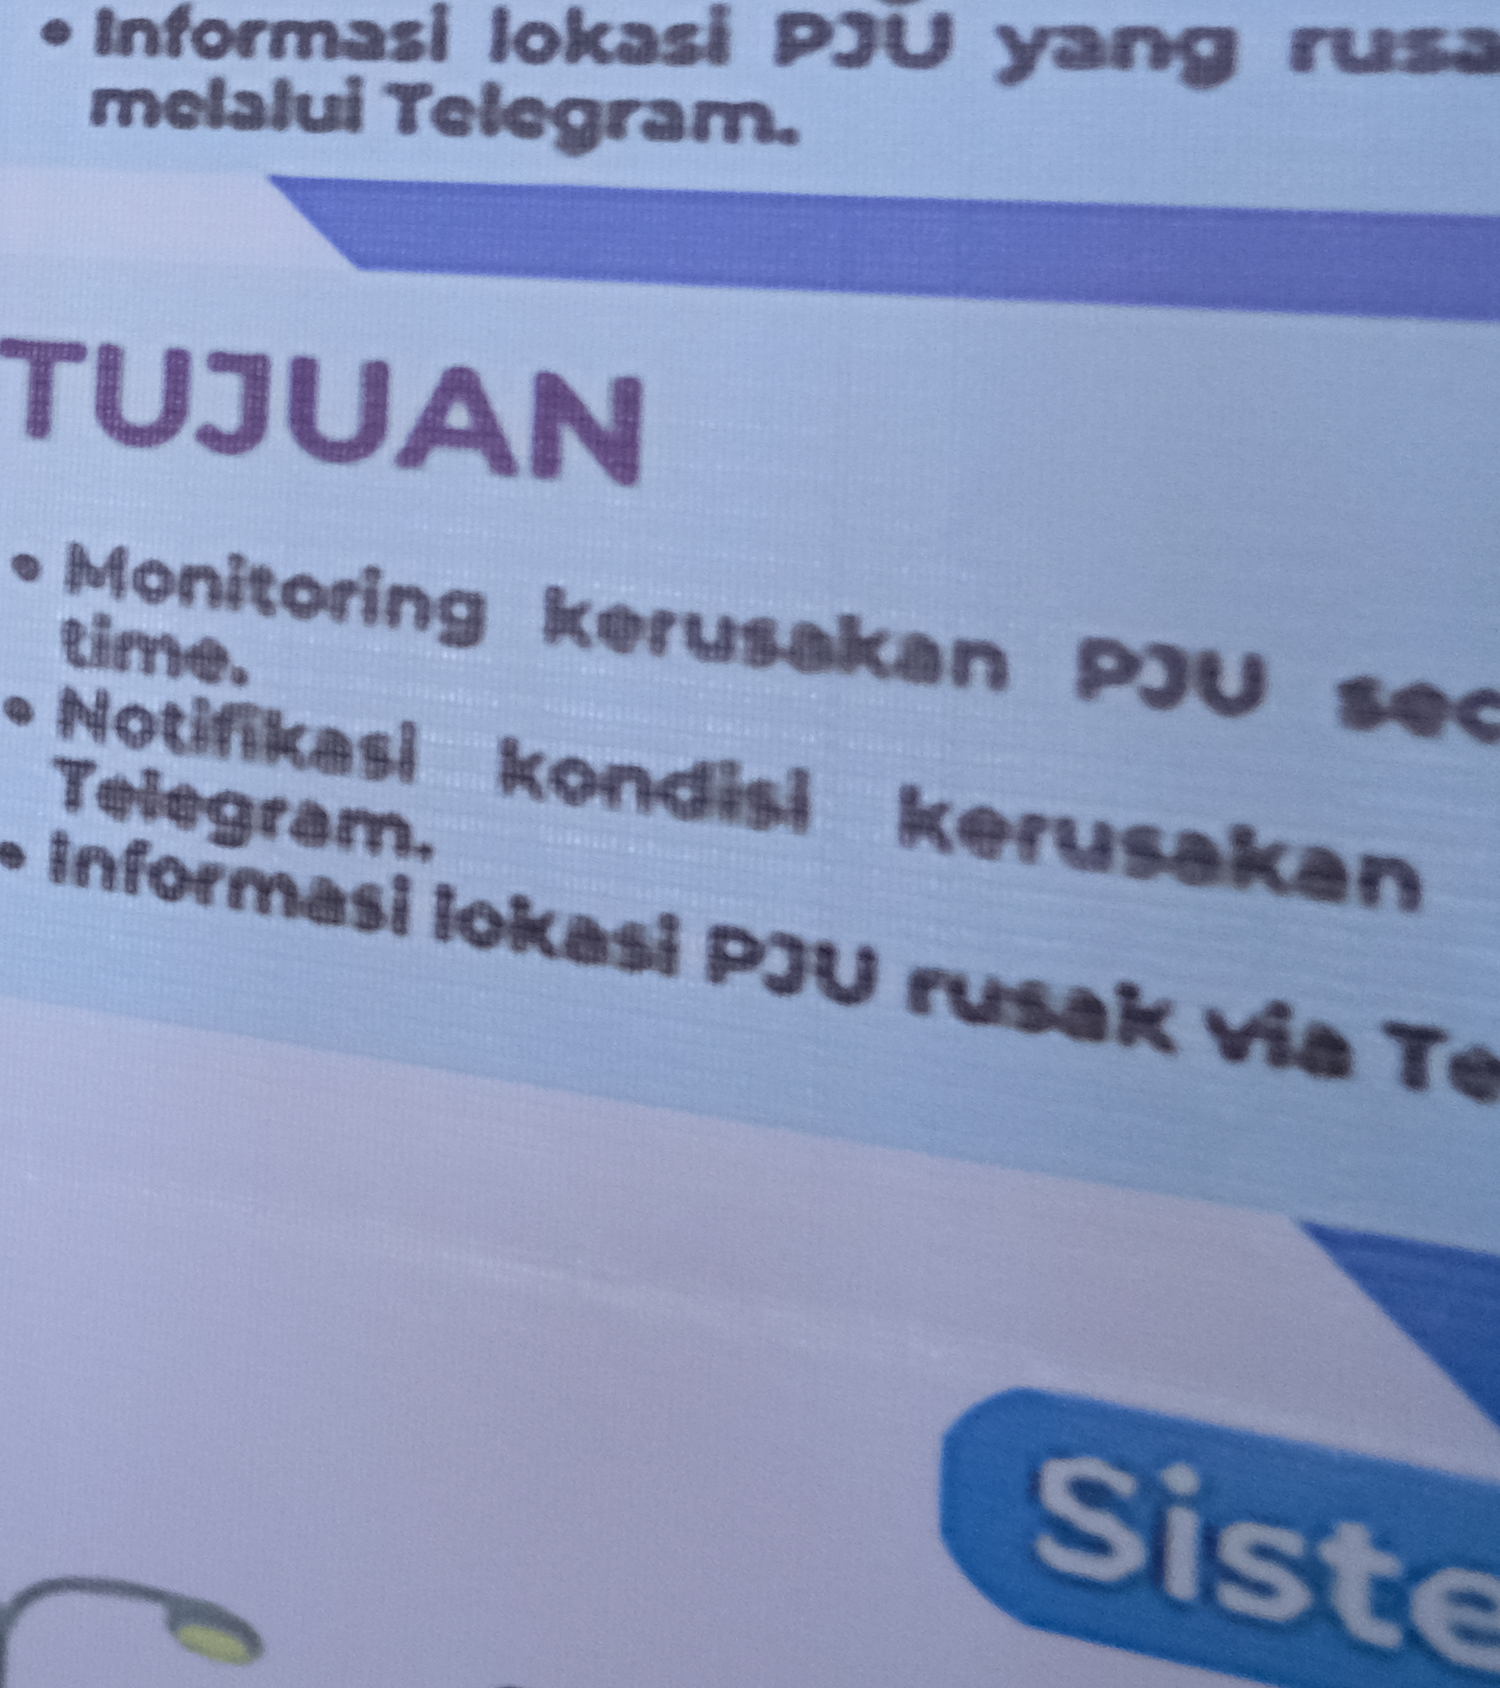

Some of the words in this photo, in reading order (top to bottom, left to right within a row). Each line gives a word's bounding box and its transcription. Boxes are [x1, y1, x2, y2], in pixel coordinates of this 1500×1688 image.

[89, 74, 364, 134] melalui
[384, 81, 800, 157] Telegram.
[95, 1, 448, 62] Informasi
[490, 2, 730, 67] lokasi
[773, 10, 955, 69] PJU
[995, 22, 1238, 90] yang
[1290, 24, 1500, 75] rusa
[0, 337, 644, 487] TUJUAN
[61, 614, 249, 687] time.
[65, 541, 488, 648] Monitoring
[541, 584, 1009, 693] kerusakan
[1075, 636, 1268, 717] PJU
[1334, 674, 1500, 745] sec
[53, 756, 434, 864] Telegram.
[56, 686, 419, 786] Notifikasi
[497, 734, 811, 836] kondisi
[898, 782, 1422, 913] kerusakan
[49, 829, 411, 937] Informasi
[434, 883, 681, 976] lokasi
[705, 924, 879, 1007] PJU
[906, 967, 1178, 1056] rusak
[1203, 999, 1353, 1079] via
[1381, 1019, 1500, 1106] Te
[1034, 1456, 1500, 1673] Siste
